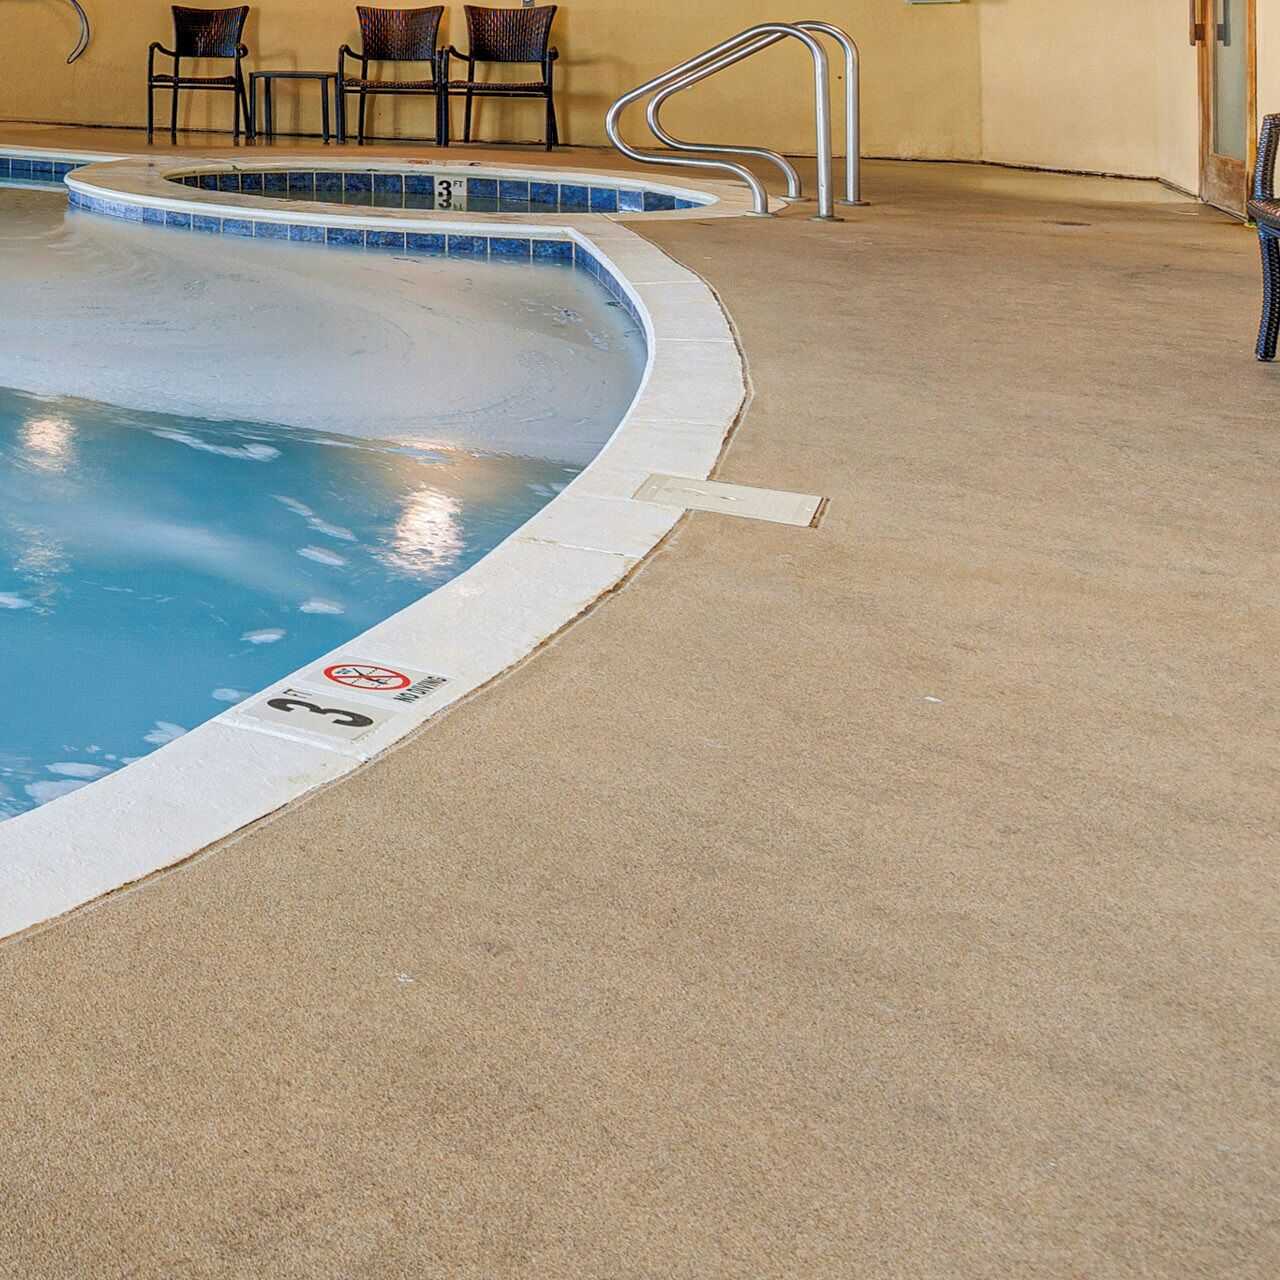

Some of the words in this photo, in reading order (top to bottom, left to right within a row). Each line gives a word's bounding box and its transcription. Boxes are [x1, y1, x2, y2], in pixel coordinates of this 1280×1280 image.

[438, 180, 452, 197] 3
[453, 180, 464, 188] FT
[267, 698, 374, 727] 3
